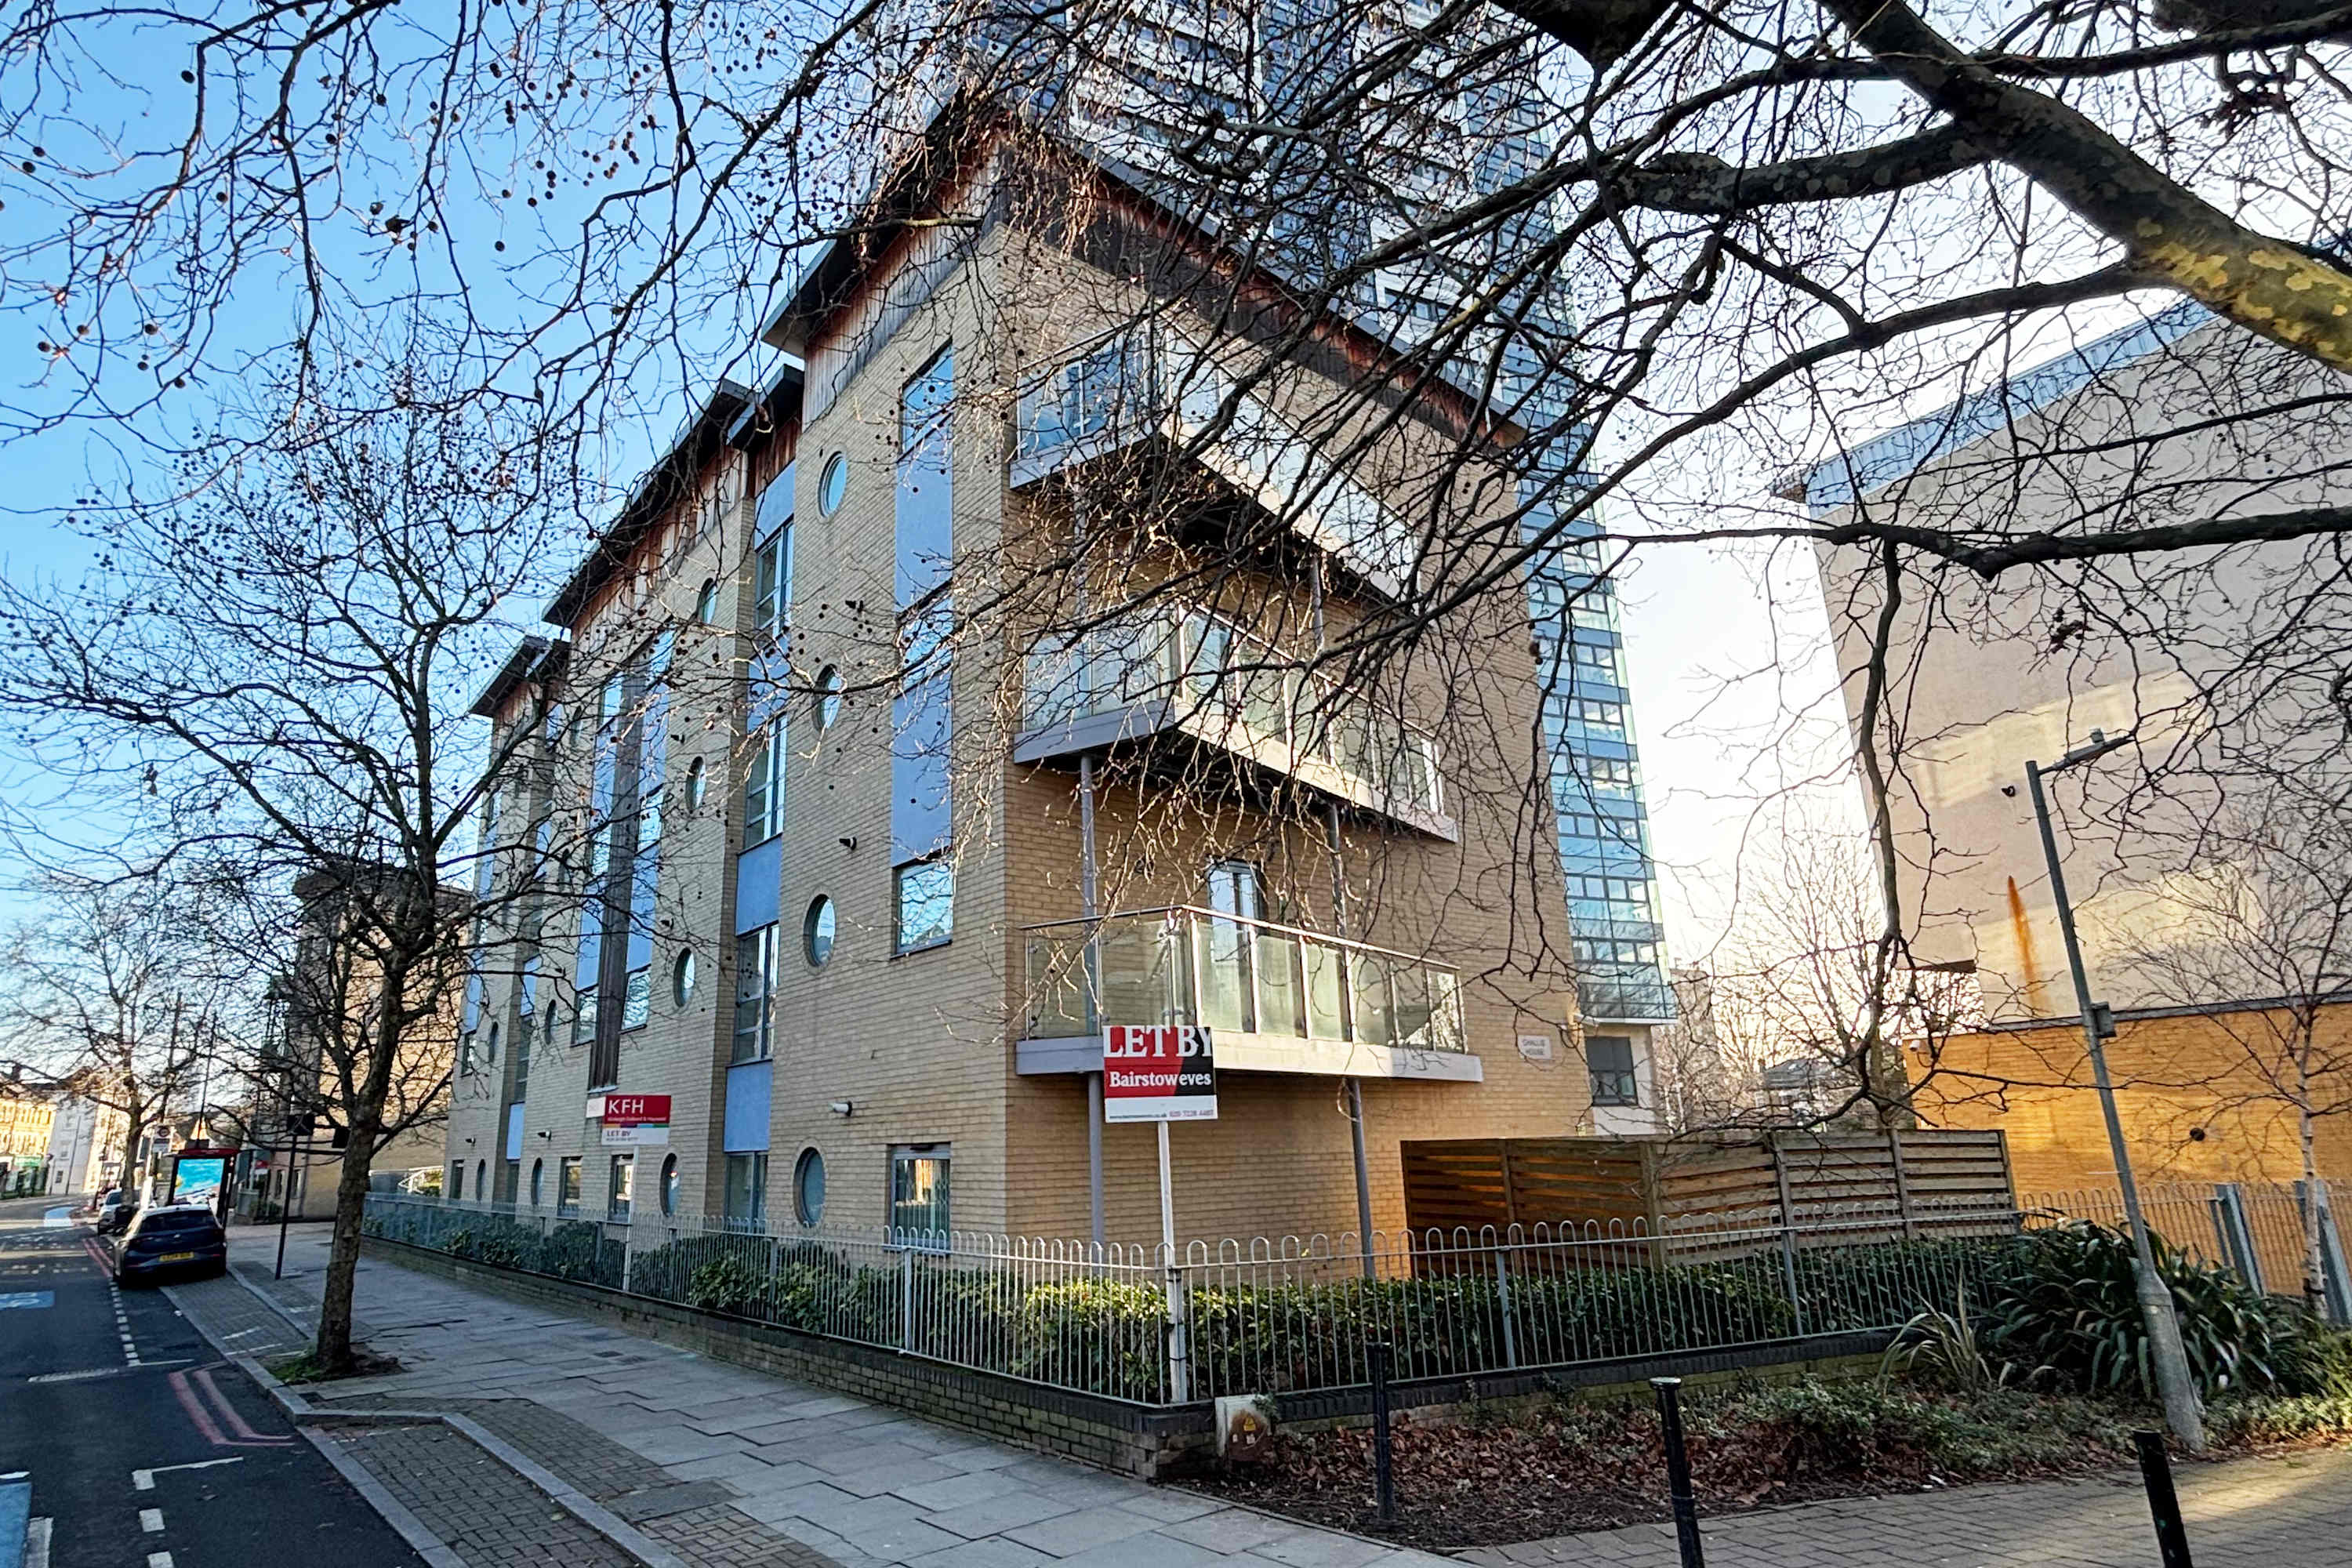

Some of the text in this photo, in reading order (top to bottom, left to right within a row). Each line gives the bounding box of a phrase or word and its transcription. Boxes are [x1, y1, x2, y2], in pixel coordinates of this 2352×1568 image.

[1104, 1025, 1213, 1057] LET BY
[1109, 1071, 1212, 1087] Bairstoweves
[608, 1099, 644, 1113] KFH
